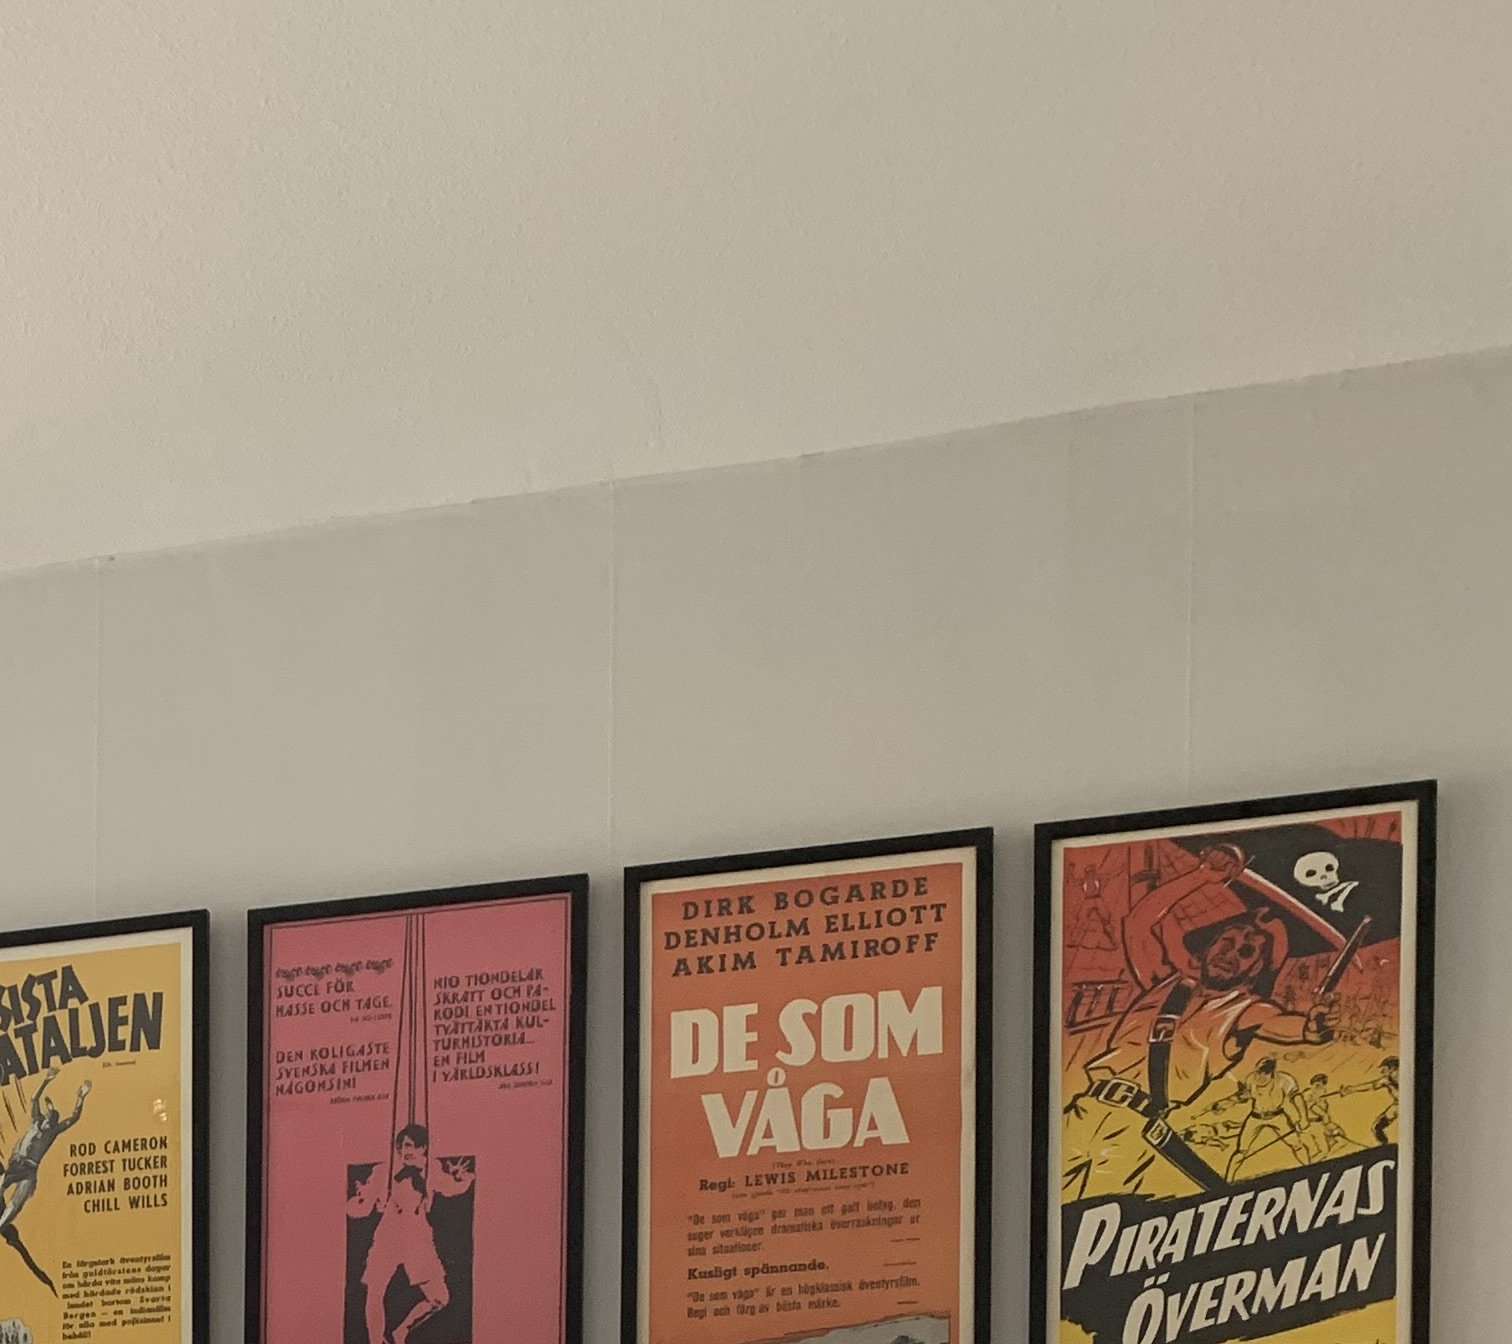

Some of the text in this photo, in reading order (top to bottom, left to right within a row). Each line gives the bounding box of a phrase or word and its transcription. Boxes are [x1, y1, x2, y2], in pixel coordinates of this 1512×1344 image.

[682, 877, 928, 920] DIRK BOGARDE
[664, 903, 947, 951] DENHOLM ELLIOTT
[672, 933, 938, 977] AKIM TAMIROFF
[326, 978, 354, 994] FÖR
[433, 968, 543, 989] NIO TIONDELAR
[491, 986, 521, 1000] OCH
[276, 1002, 315, 1018] HASSE
[320, 999, 350, 1013] OCH
[496, 998, 556, 1015] TIONDEL
[670, 986, 943, 1079] DE SOM
[276, 1050, 303, 1064] DEN
[433, 1050, 486, 1067] EN FILM
[276, 1058, 389, 1080] SVENSKA FILMEN
[701, 1067, 910, 1159] VÅGA
[70, 1136, 168, 1158] ROD CAMERON
[63, 1155, 167, 1177] FORREST TUCKER
[699, 1177, 735, 1192] Regi:
[745, 1172, 796, 1187] LEWIS
[806, 1162, 909, 1182] MILESTONE
[66, 1174, 168, 1196] ADRIAN BOOTH
[84, 1193, 168, 1213] CHILL WILLS
[1061, 1159, 1395, 1290] PIRATERNAS
[687, 1266, 737, 1280] Kusligt
